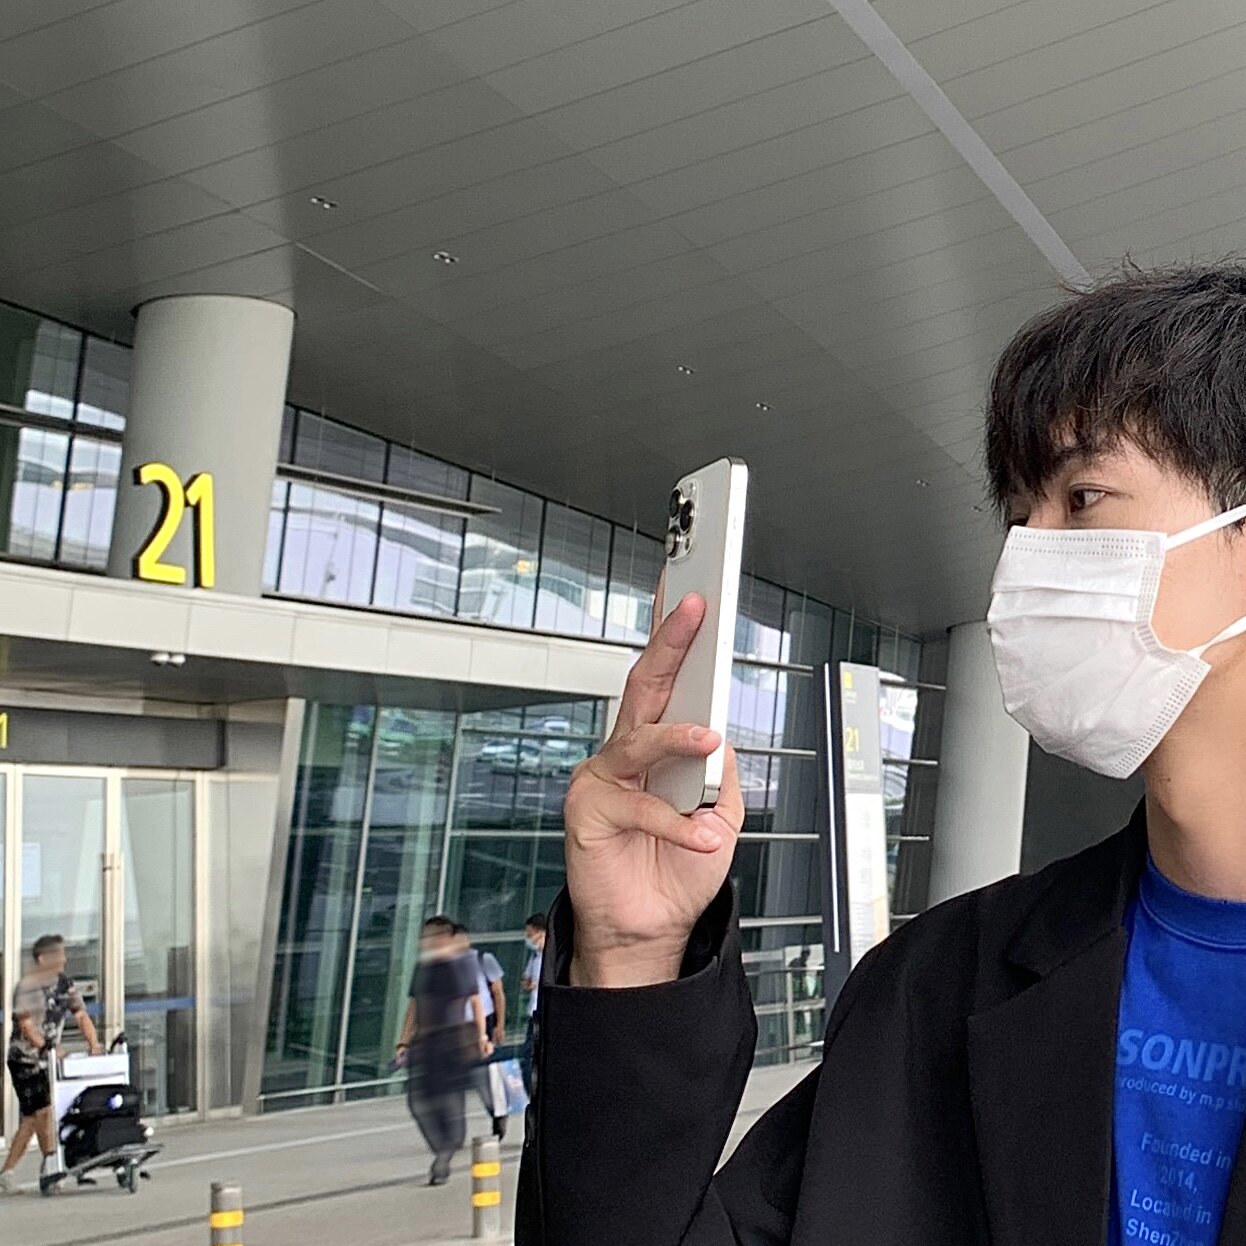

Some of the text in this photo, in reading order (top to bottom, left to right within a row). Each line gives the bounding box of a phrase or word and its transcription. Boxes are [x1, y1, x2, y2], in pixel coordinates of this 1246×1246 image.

[136, 461, 215, 588] 21
[1179, 1086, 1196, 1104] by
[1141, 1132, 1213, 1165] Founded
[1196, 1205, 1211, 1225] in
